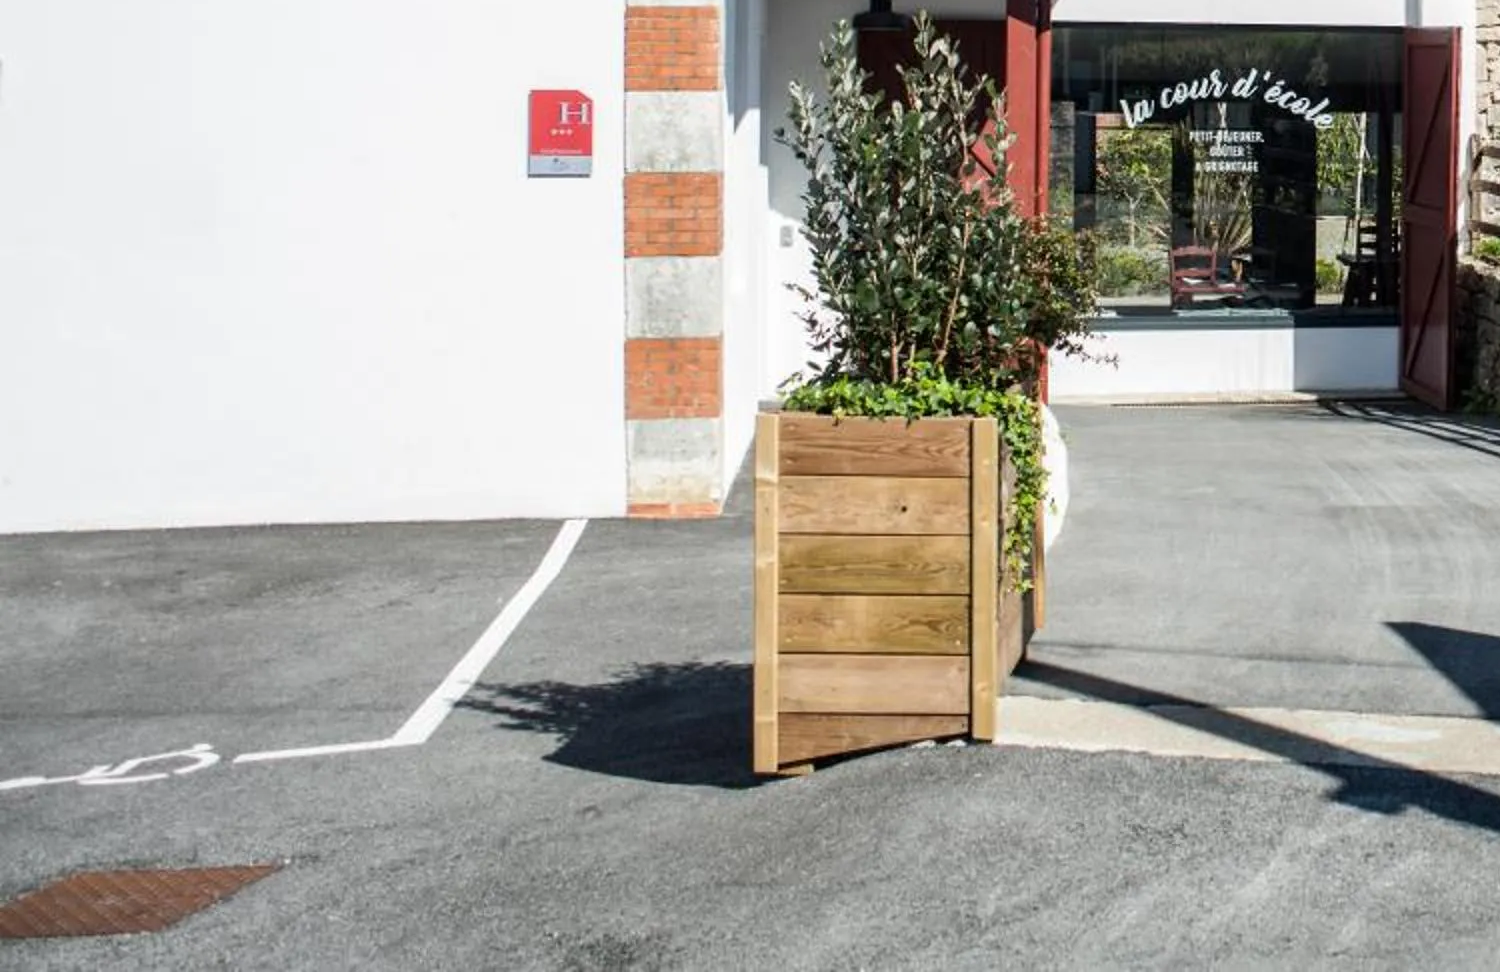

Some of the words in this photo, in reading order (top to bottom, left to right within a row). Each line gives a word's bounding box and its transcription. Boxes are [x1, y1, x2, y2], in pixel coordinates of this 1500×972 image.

[558, 101, 592, 126] H
[1119, 99, 1155, 129] la
[1160, 68, 1228, 110] cour
[1231, 67, 1334, 130] d'école
